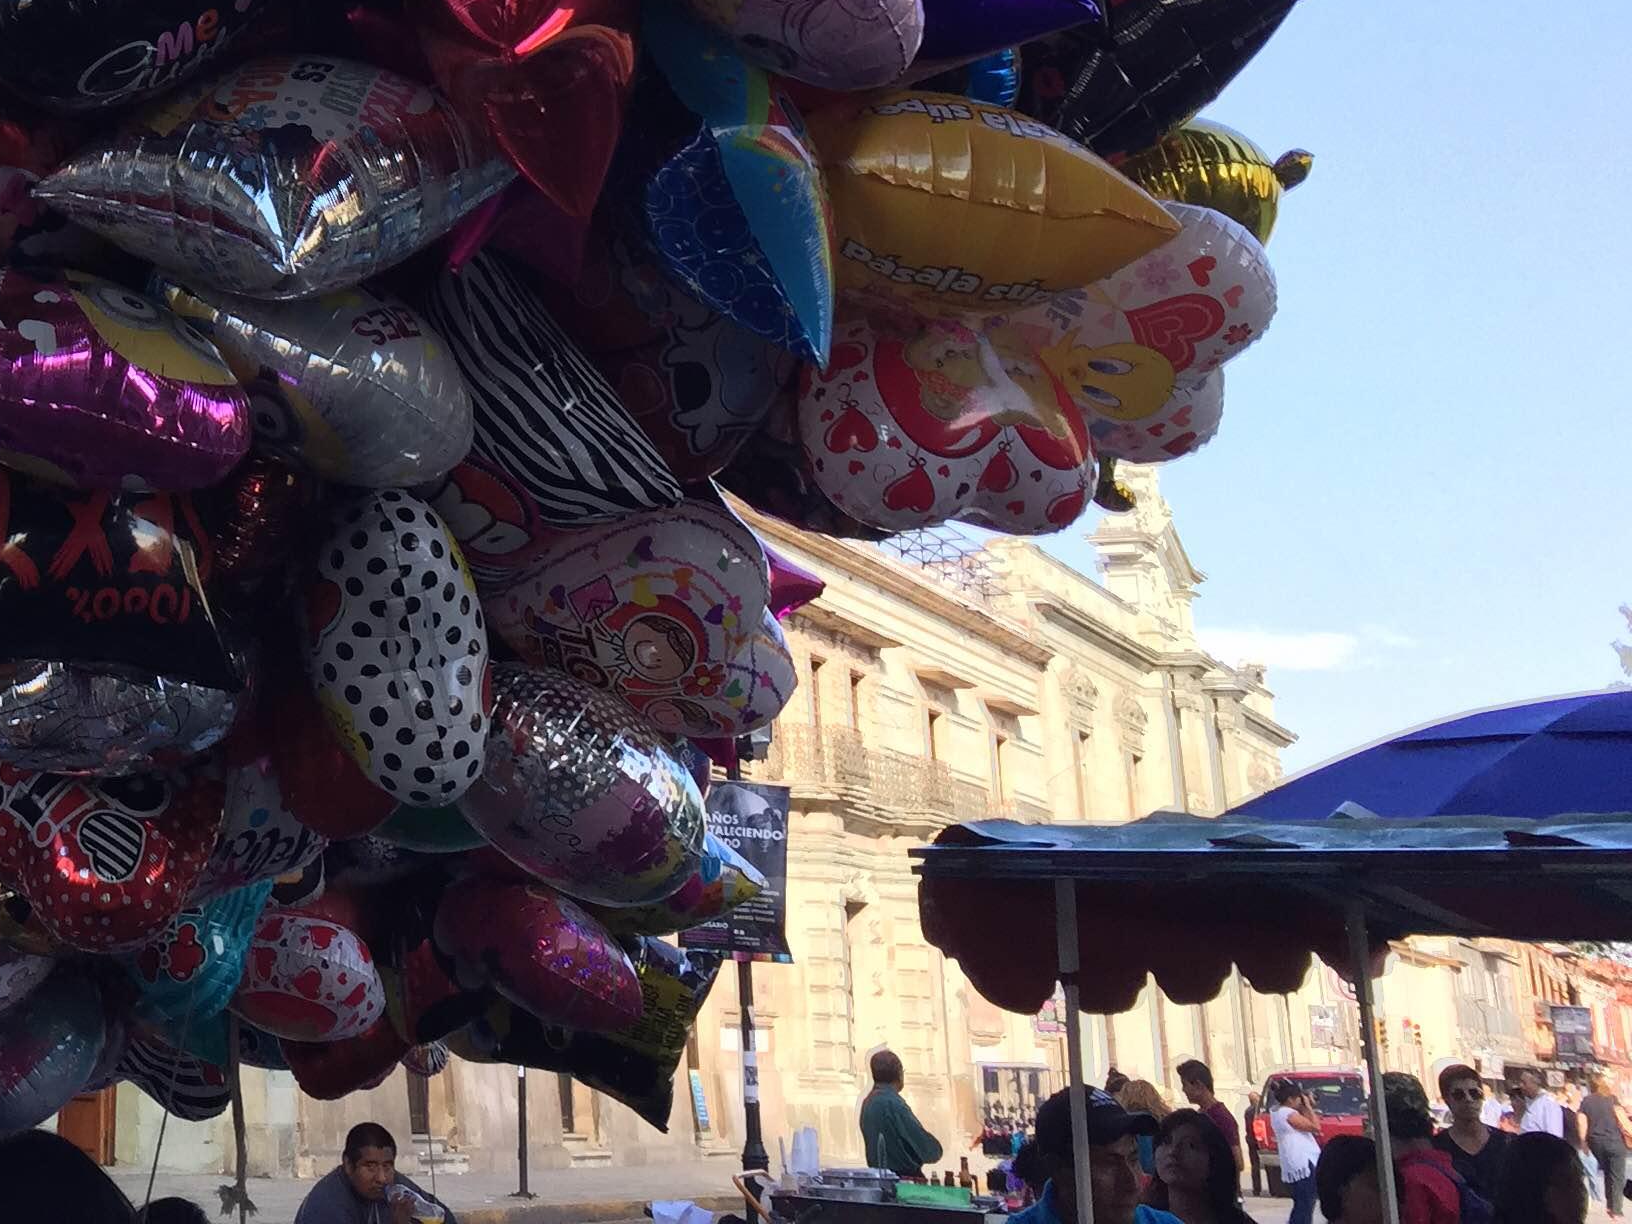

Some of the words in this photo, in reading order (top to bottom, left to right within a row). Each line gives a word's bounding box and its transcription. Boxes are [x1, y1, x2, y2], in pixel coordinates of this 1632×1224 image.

[290, 61, 335, 83] ES
[841, 236, 984, 296] Pásala
[708, 823, 783, 842] TALECIENDO
